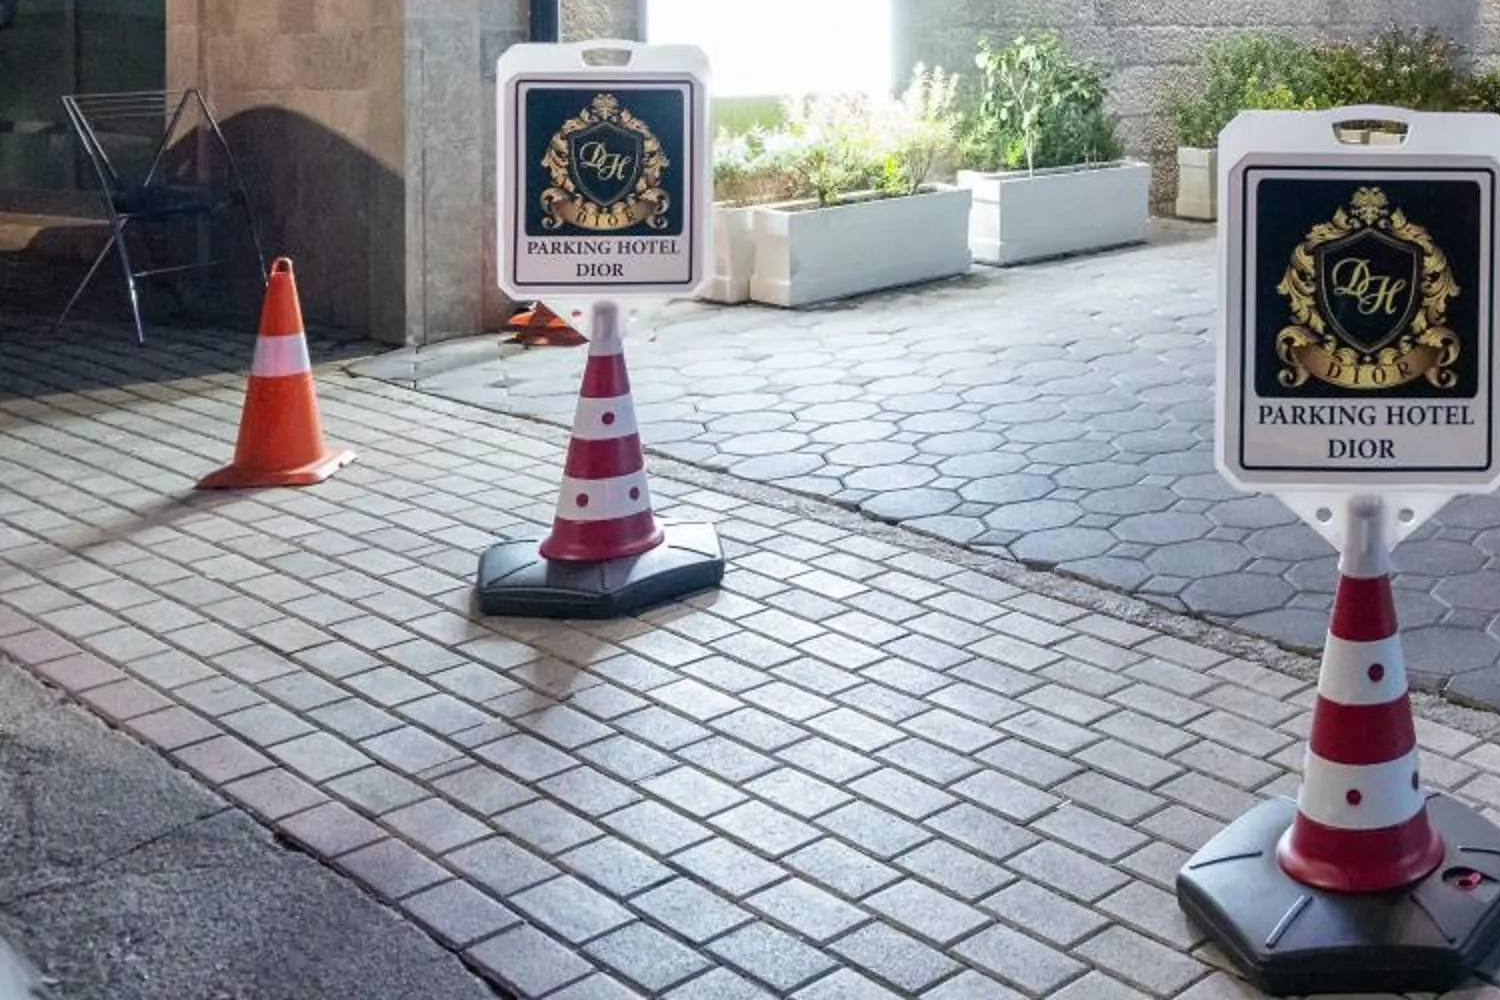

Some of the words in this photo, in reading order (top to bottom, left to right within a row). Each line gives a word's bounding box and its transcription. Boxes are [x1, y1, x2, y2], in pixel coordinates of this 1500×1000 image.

[528, 240, 611, 255] PARKING
[617, 240, 681, 254] HOTEL
[576, 263, 624, 277] DIOR
[1325, 360, 1409, 385] DIOR
[1258, 405, 1376, 425] PARKING
[1386, 405, 1475, 425] HOTEL
[1327, 439, 1396, 459] DIOR
